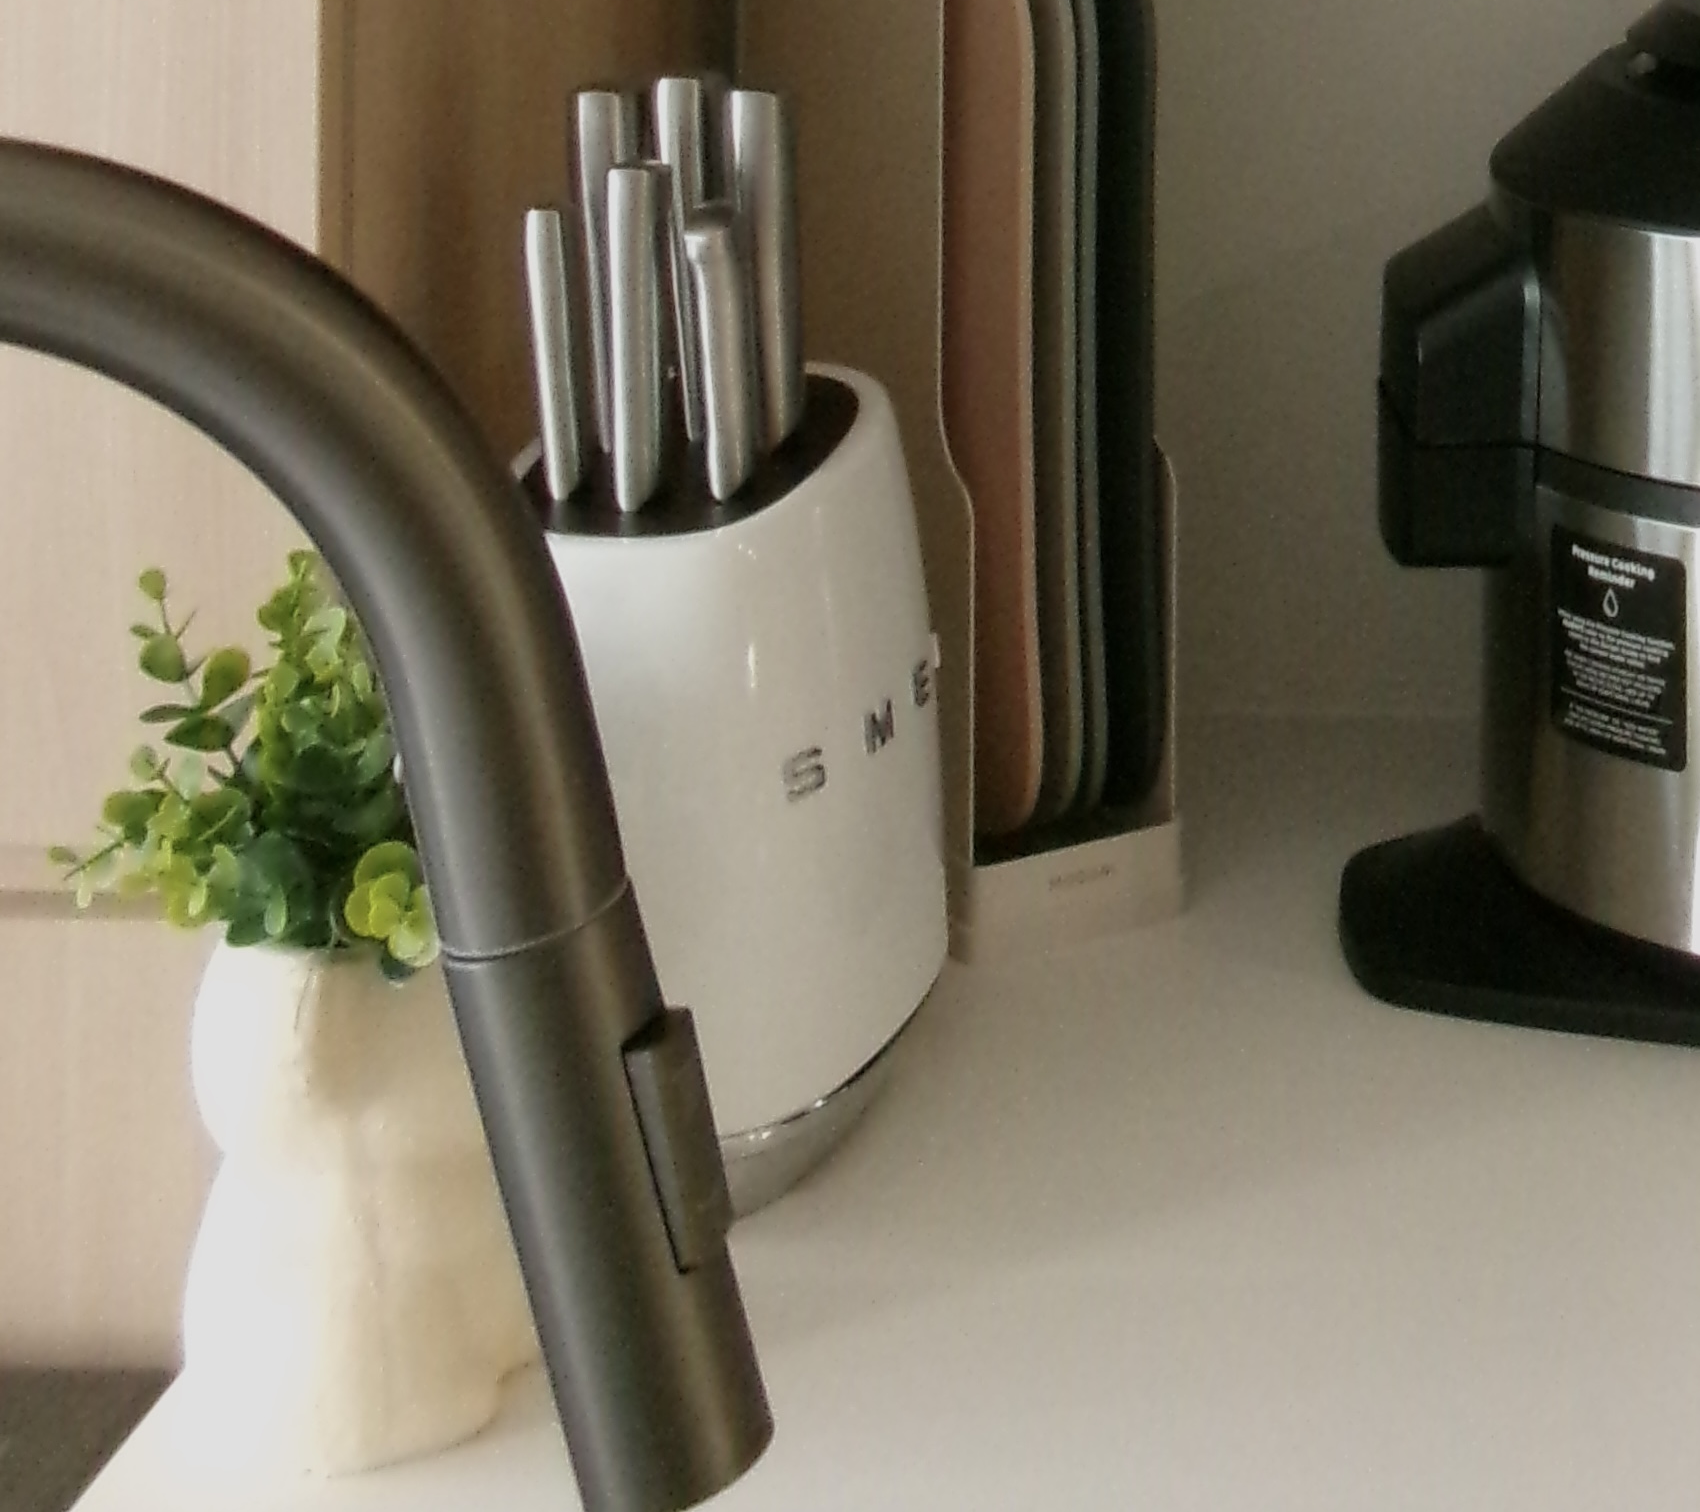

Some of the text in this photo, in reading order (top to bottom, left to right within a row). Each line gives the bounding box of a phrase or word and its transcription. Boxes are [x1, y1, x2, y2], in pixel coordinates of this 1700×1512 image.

[1571, 543, 1656, 582] Pressure Cooking
[1587, 564, 1636, 590] Reminder
[782, 633, 943, 803] SME
